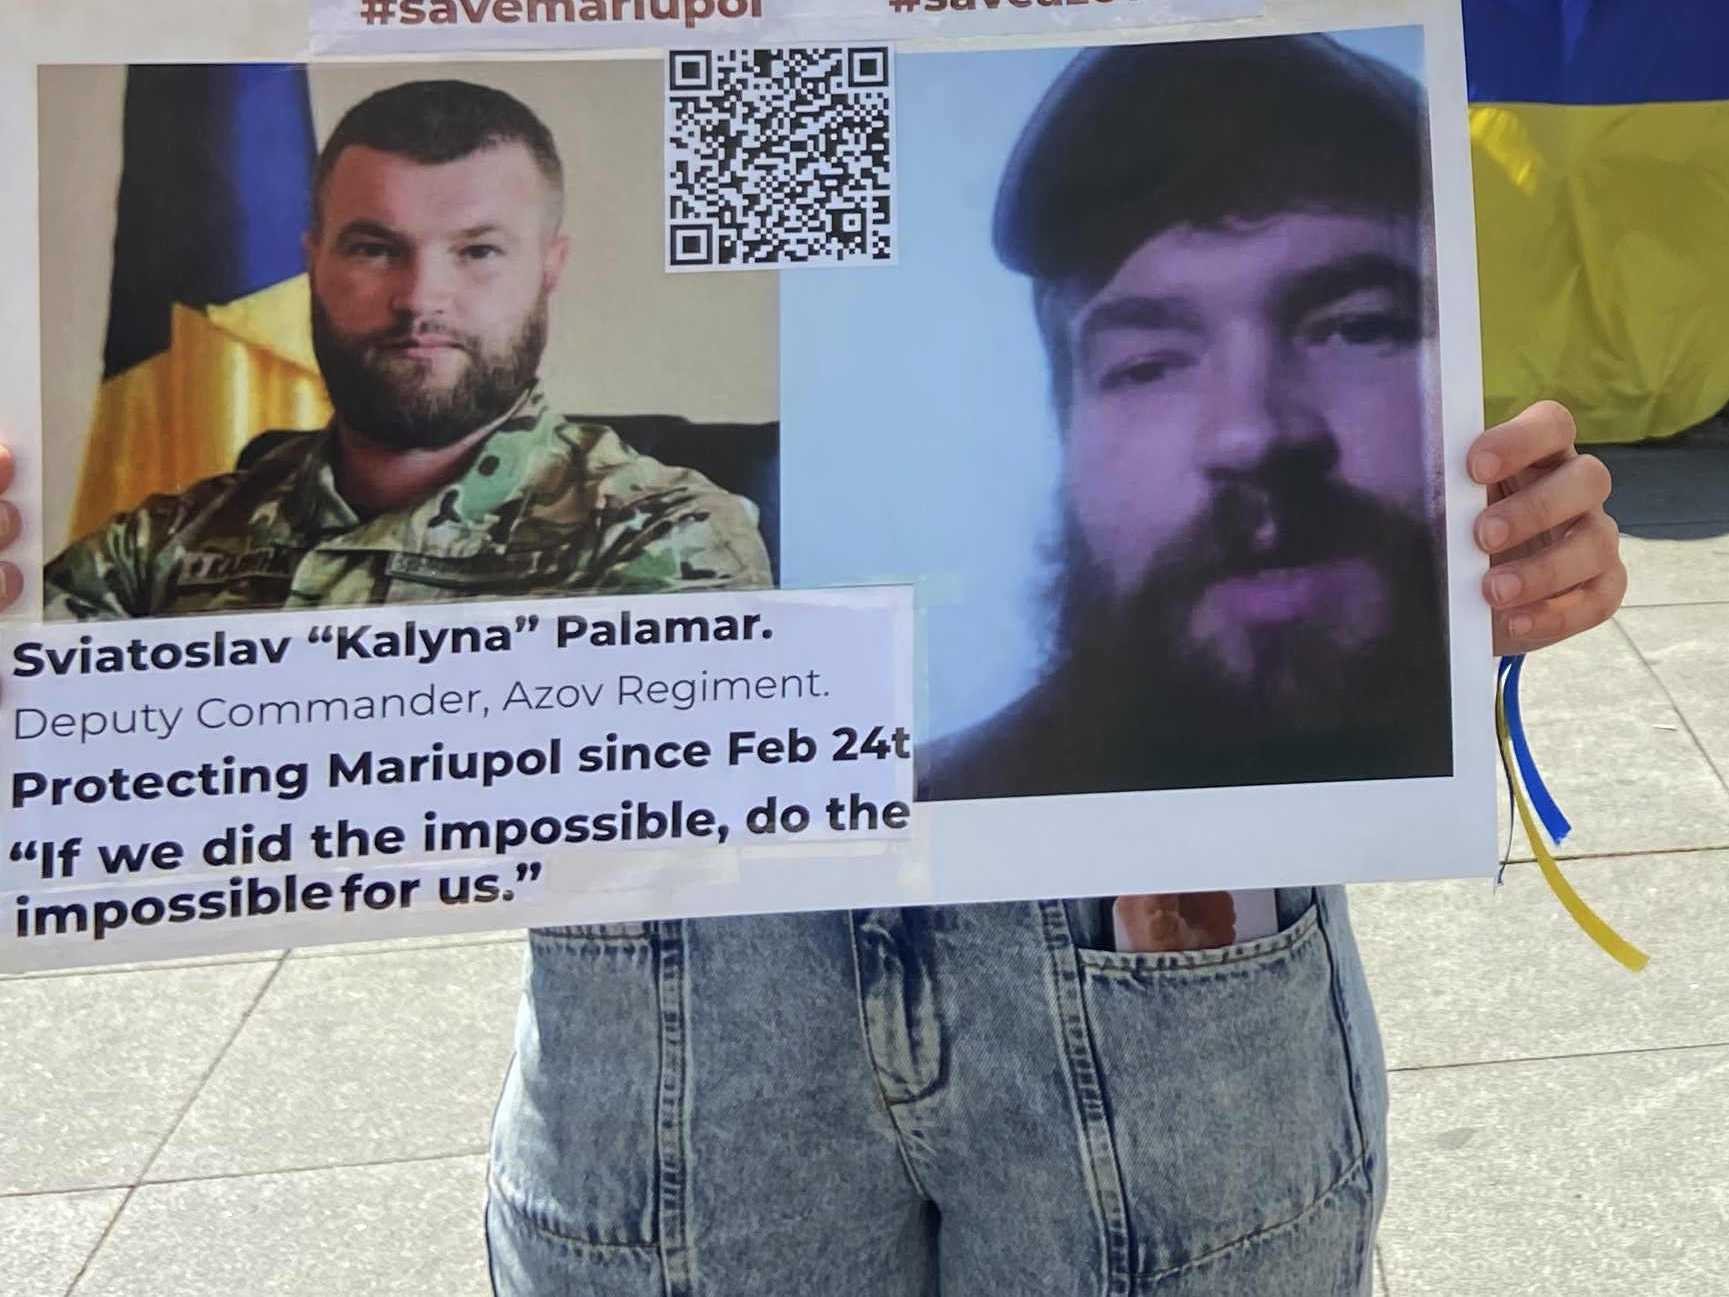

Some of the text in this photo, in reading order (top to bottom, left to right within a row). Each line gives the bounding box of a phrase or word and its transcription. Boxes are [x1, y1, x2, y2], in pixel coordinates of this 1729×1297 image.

[12, 611, 774, 678] Sviatoslav “Kalyna” Palamar.
[14, 669, 830, 743] Deputy Commander, Azov Regiment.
[12, 726, 912, 808] Protecting Mariupol since Feb 24t
[9, 793, 911, 878] “If we did the impossible, do the
[16, 862, 542, 940] impossible for us.”
